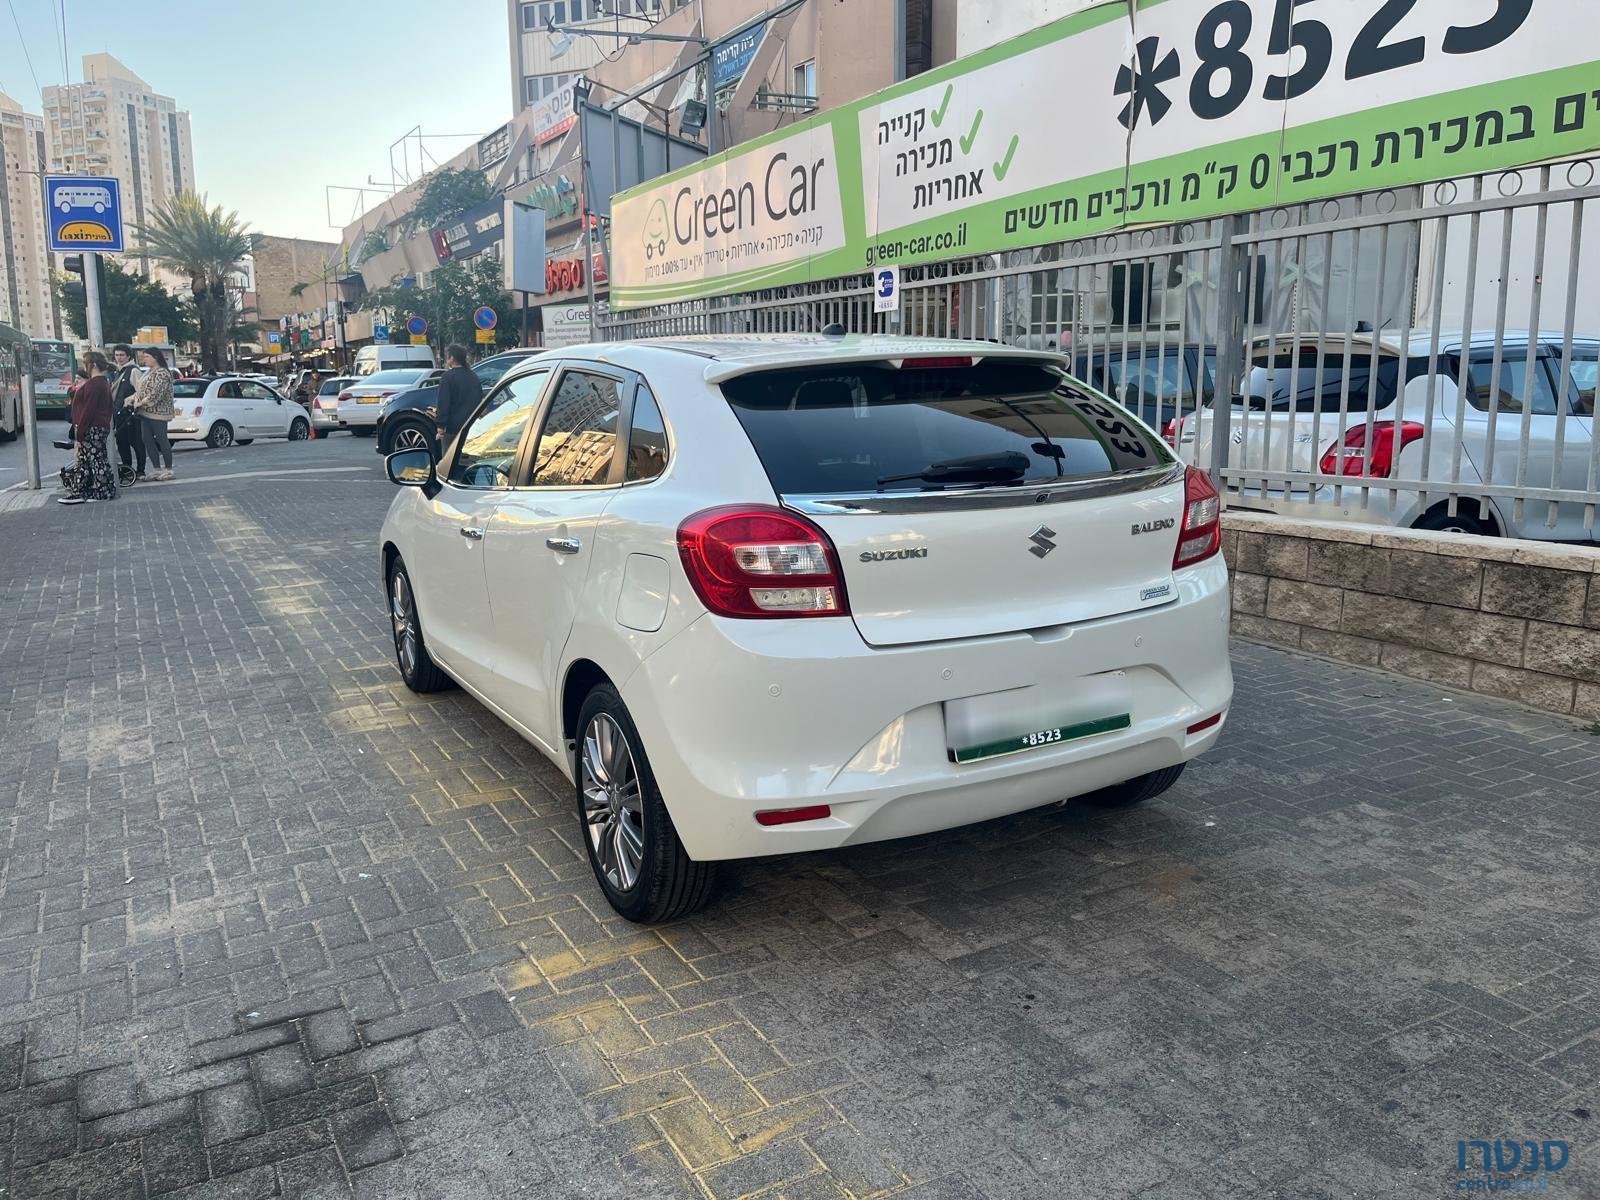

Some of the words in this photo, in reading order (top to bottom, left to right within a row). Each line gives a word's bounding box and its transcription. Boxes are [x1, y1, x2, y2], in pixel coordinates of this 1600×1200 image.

[717, 43, 739, 65] קדימה
[878, 108, 926, 146] קנייה
[1371, 104, 1536, 168] במכירת
[896, 138, 953, 177] מכירה
[1250, 153, 1270, 190] 0
[1281, 139, 1359, 183] רכבי
[674, 181, 755, 246] Green
[764, 152, 825, 221] Car
[913, 168, 984, 210] אחריות
[1086, 178, 1171, 219] ורכבים
[1004, 197, 1078, 234] חדשים
[64, 229, 83, 240] taxi
[731, 239, 760, 260] אחריות
[767, 232, 793, 252] מכירה
[801, 225, 823, 247] קניה
[866, 222, 967, 267] green-car.co.il
[662, 260, 680, 275] 100%
[566, 308, 591, 321] Gree
[1131, 518, 1175, 536] BALENO
[859, 546, 928, 562] SUZUKI
